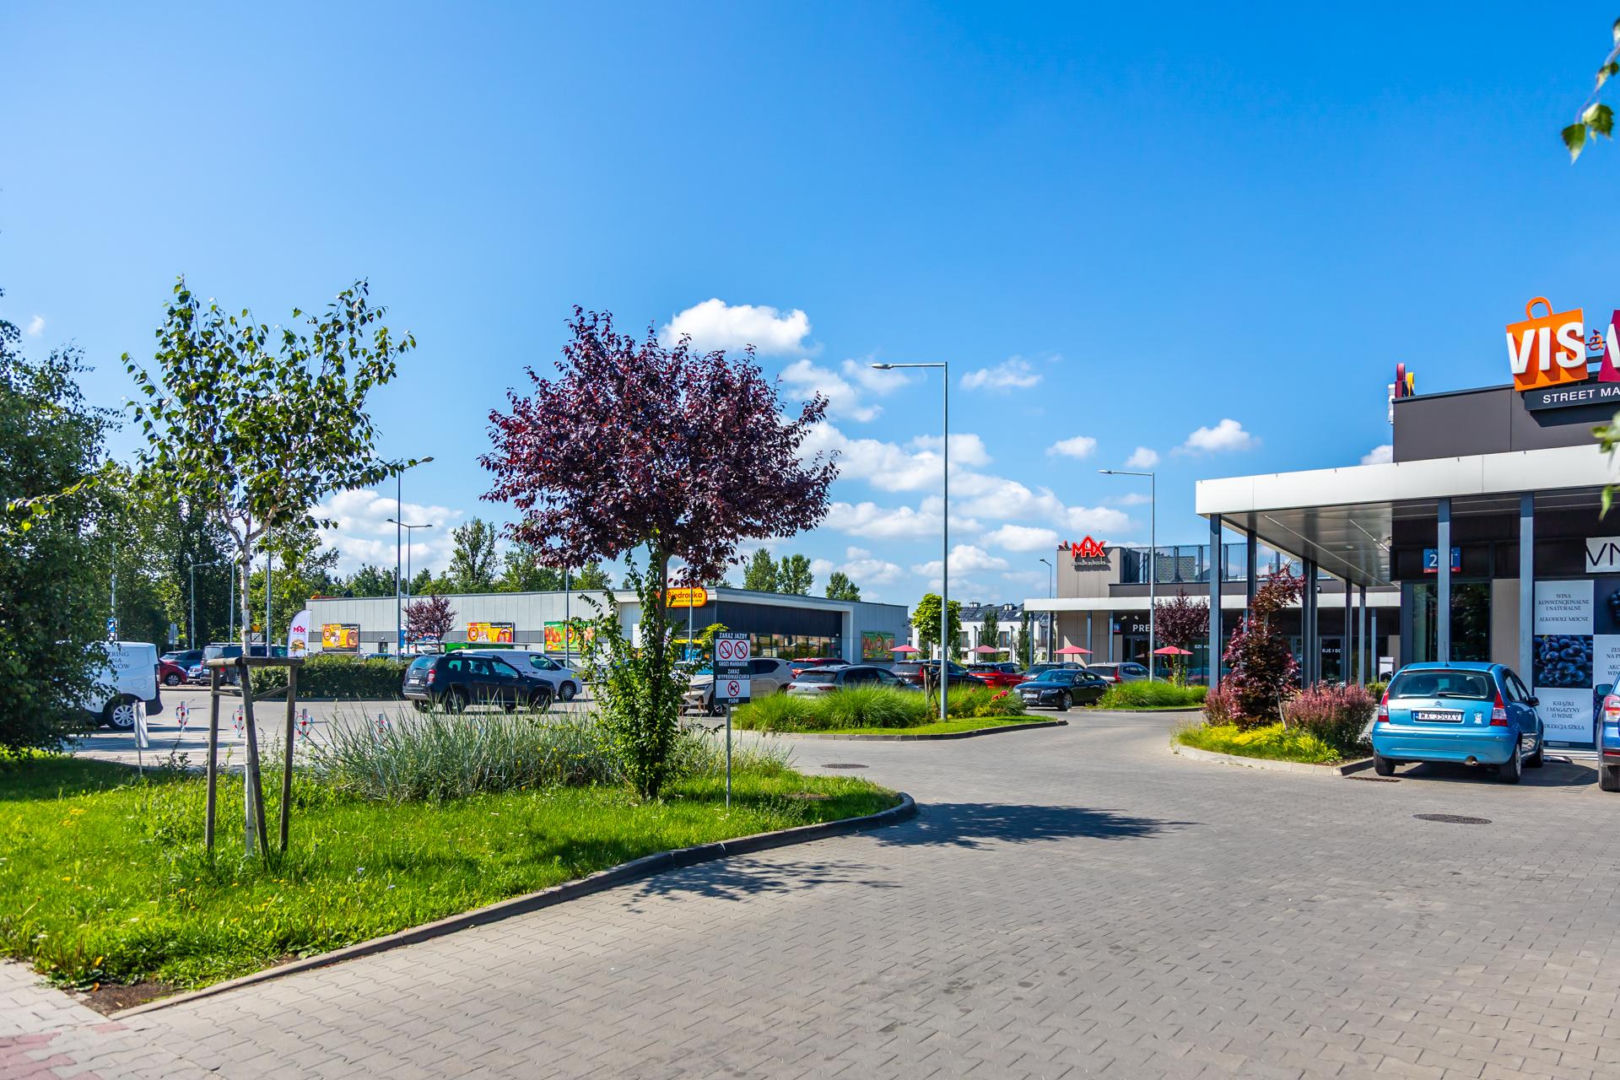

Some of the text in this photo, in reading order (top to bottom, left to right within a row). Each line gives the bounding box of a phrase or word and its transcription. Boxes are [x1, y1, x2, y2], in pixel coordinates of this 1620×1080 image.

[1506, 322, 1586, 374] VIS
[1543, 389, 1595, 404] STREET
[1072, 535, 1105, 558] MAX
[667, 591, 703, 599] Bidroka
